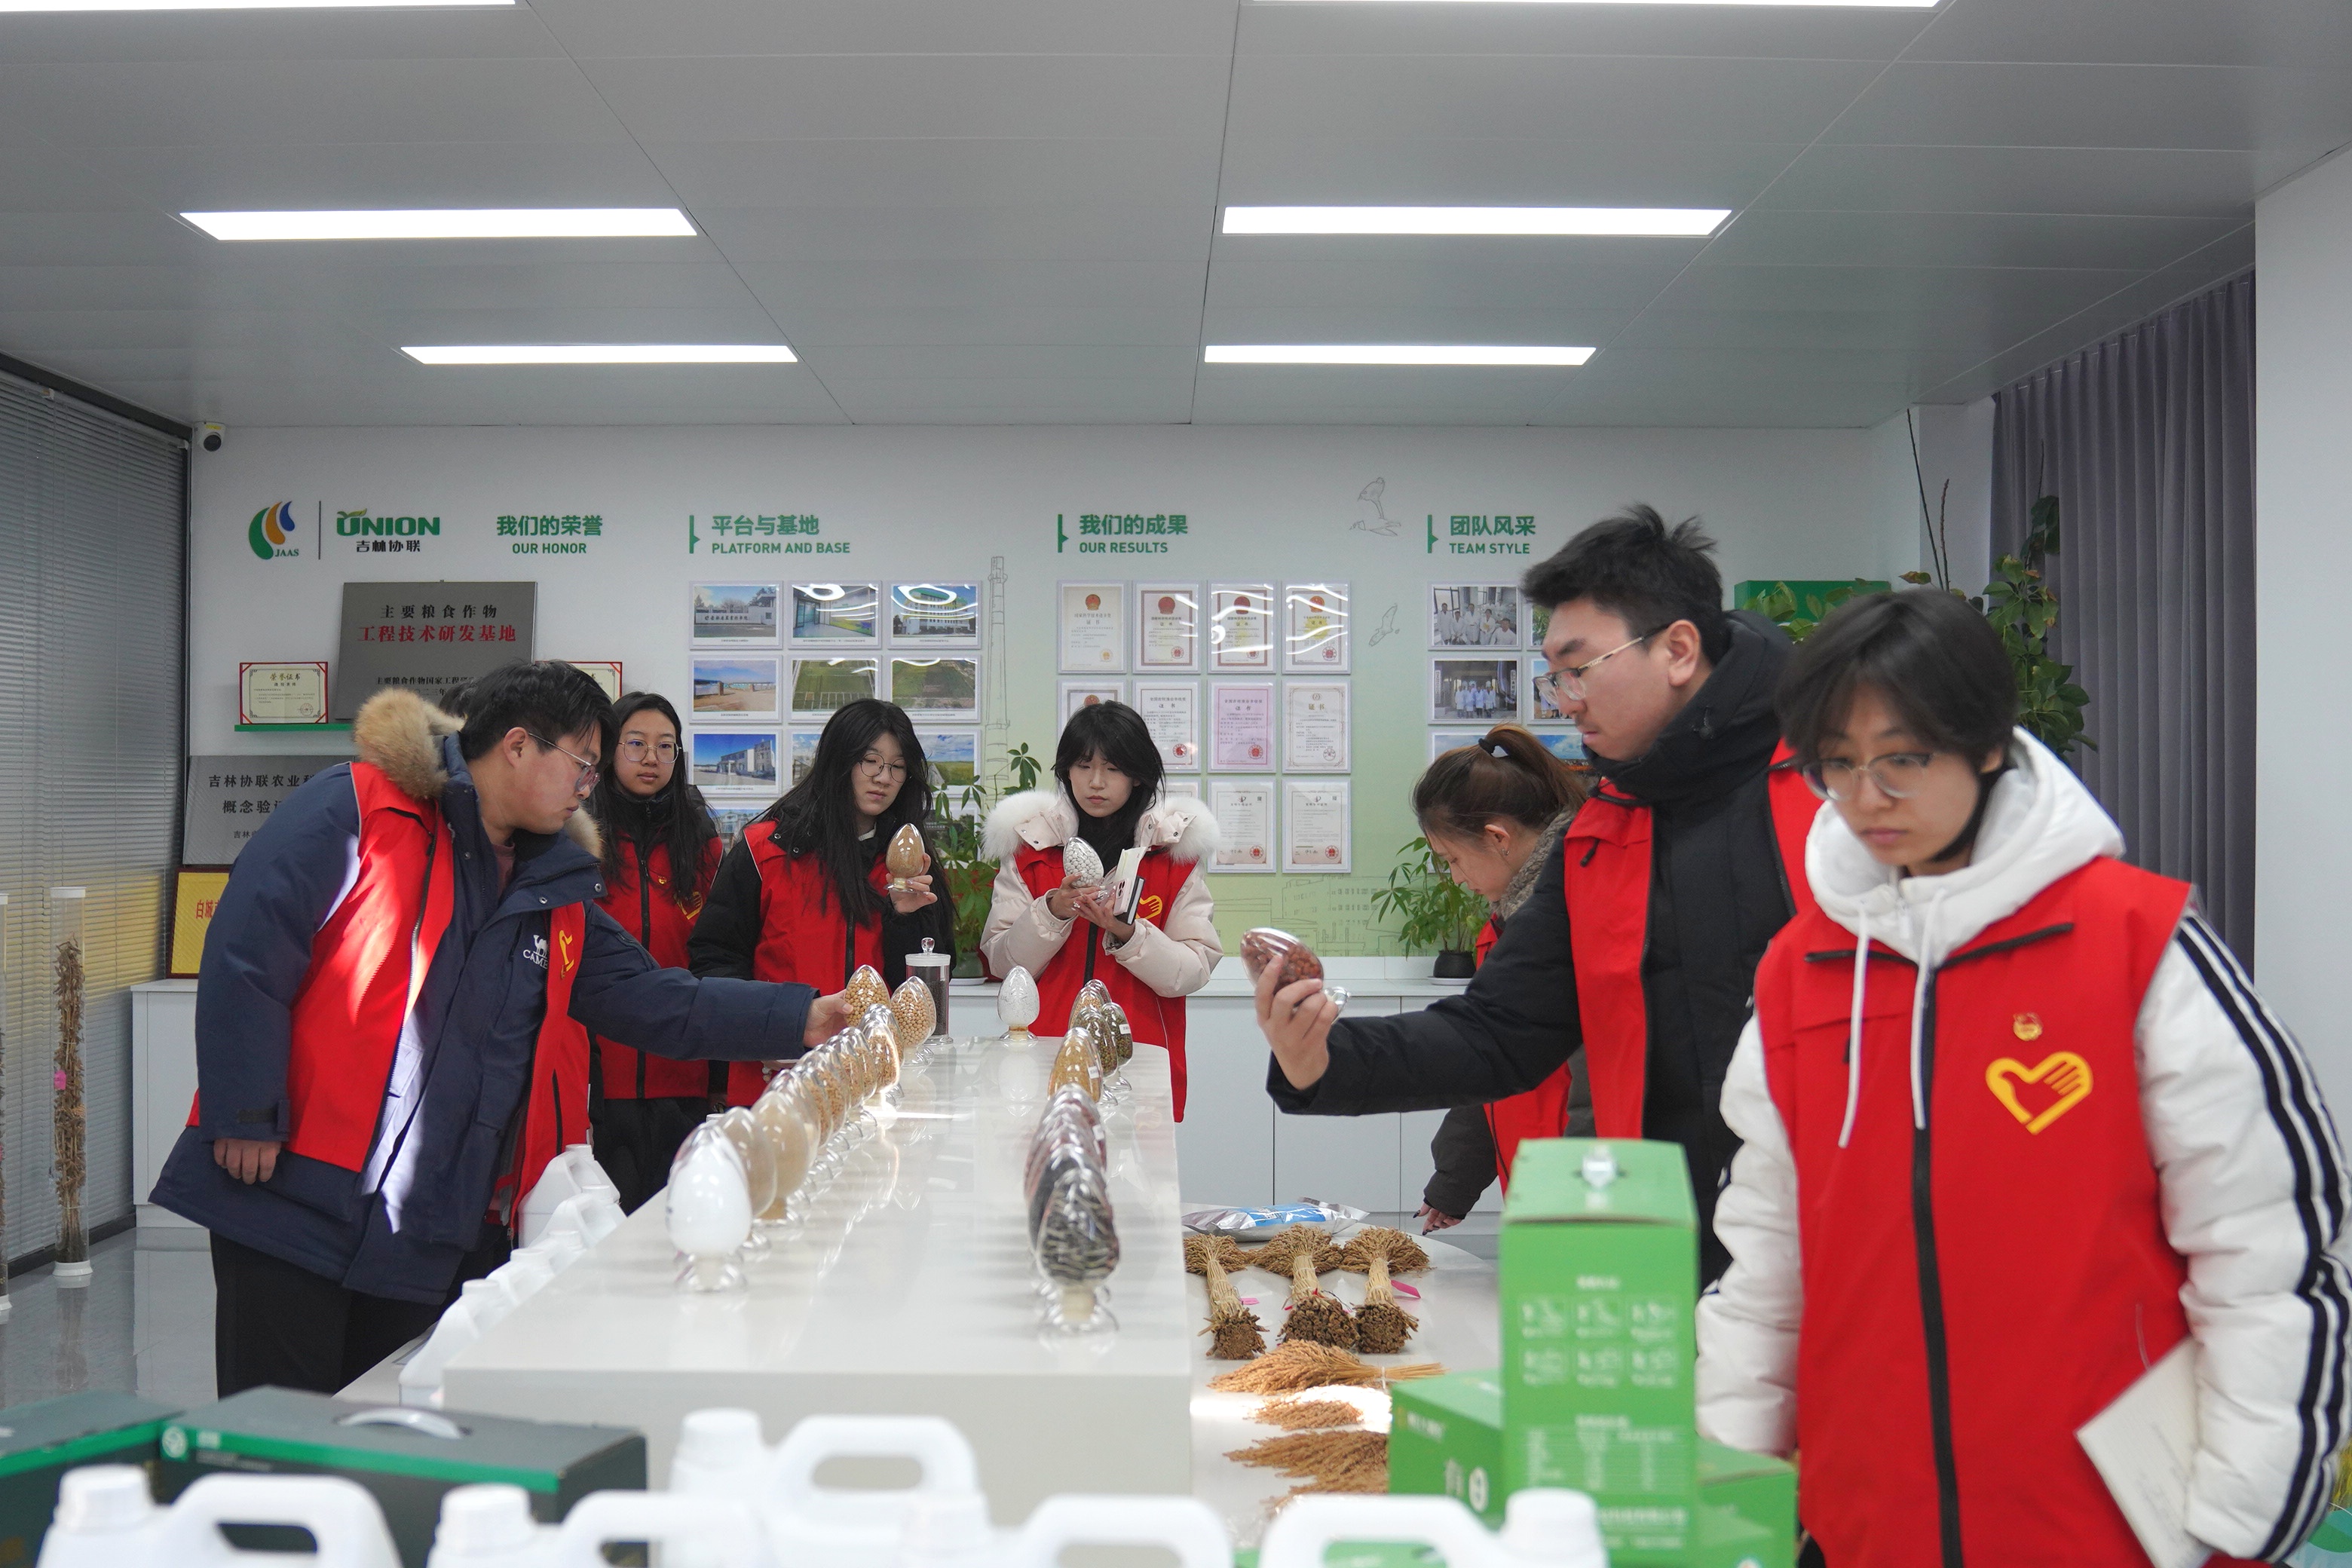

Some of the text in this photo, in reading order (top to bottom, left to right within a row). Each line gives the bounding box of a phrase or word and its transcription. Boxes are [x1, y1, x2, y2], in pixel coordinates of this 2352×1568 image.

[337, 516, 439, 536] UNION
[497, 515, 602, 536] 我们的荣誉
[712, 515, 819, 536] 平台与基地
[1080, 514, 1188, 535] 我们的成果
[1450, 515, 1536, 536] 团队风采
[275, 548, 299, 556] JAAS
[356, 540, 421, 553] 吉林协联
[512, 543, 586, 554] OUR HONOR
[712, 543, 850, 554] PLATFORM AND BASE
[1080, 542, 1168, 553] OUR RESULTS
[1449, 543, 1530, 553] TEAM STYLE
[380, 605, 497, 618] 主要粮食作物
[358, 625, 516, 642] 工程技术研发基地
[522, 949, 549, 969] CAME
